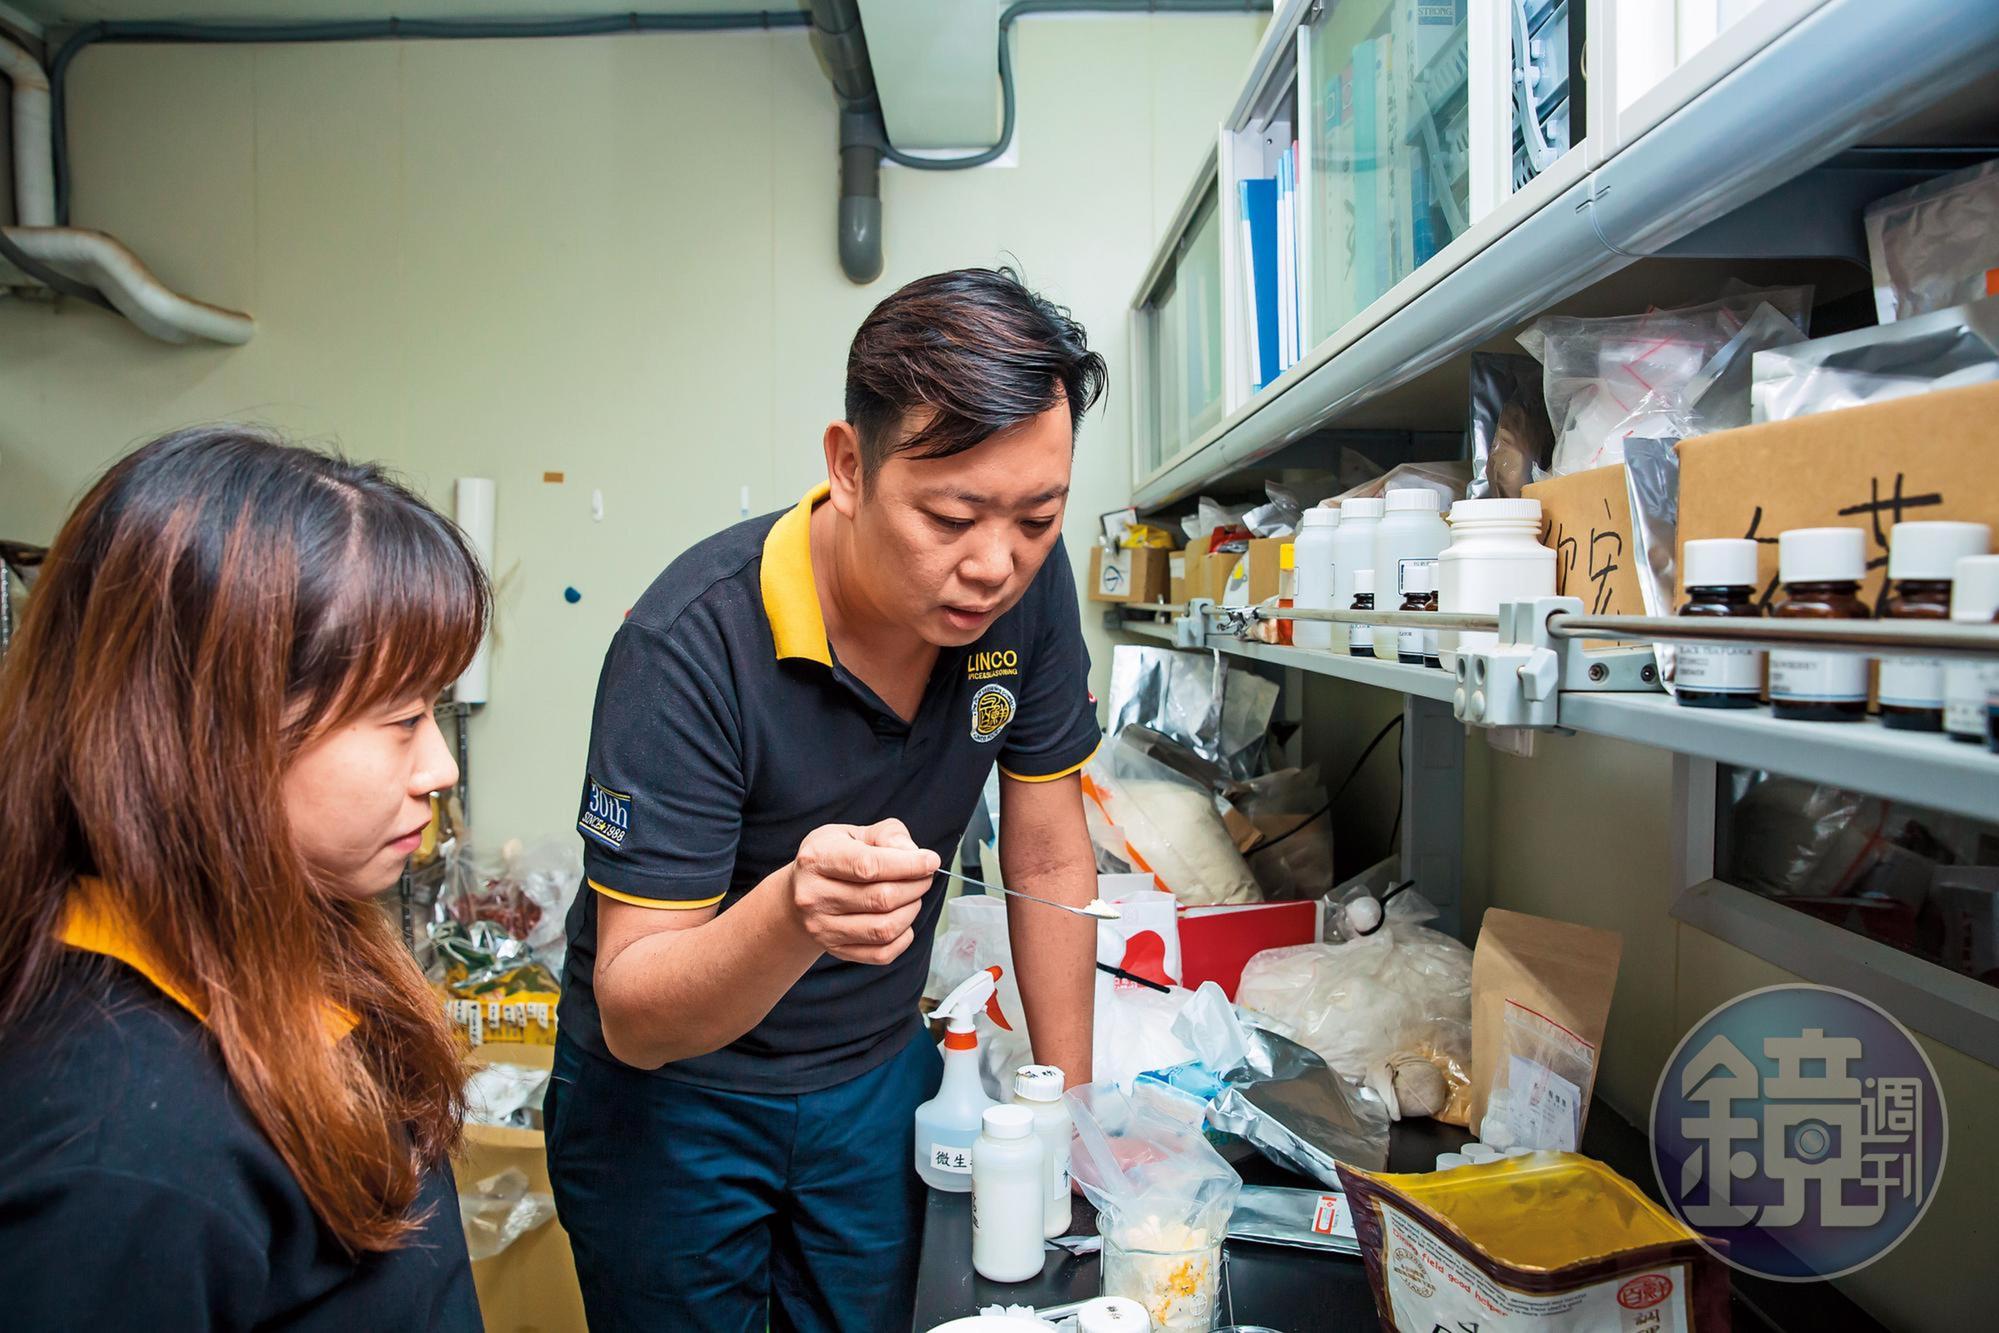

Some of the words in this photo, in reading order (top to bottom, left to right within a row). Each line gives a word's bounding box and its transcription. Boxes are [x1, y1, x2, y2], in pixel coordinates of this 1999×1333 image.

[967, 650, 1018, 672] LINCO
[589, 782, 628, 830] 30th
[602, 824, 626, 842] 1988
[935, 1150, 973, 1169] 微生
[1422, 1252, 1445, 1275] field
[1447, 1272, 1472, 1295] good
[1474, 1289, 1509, 1317] helper
